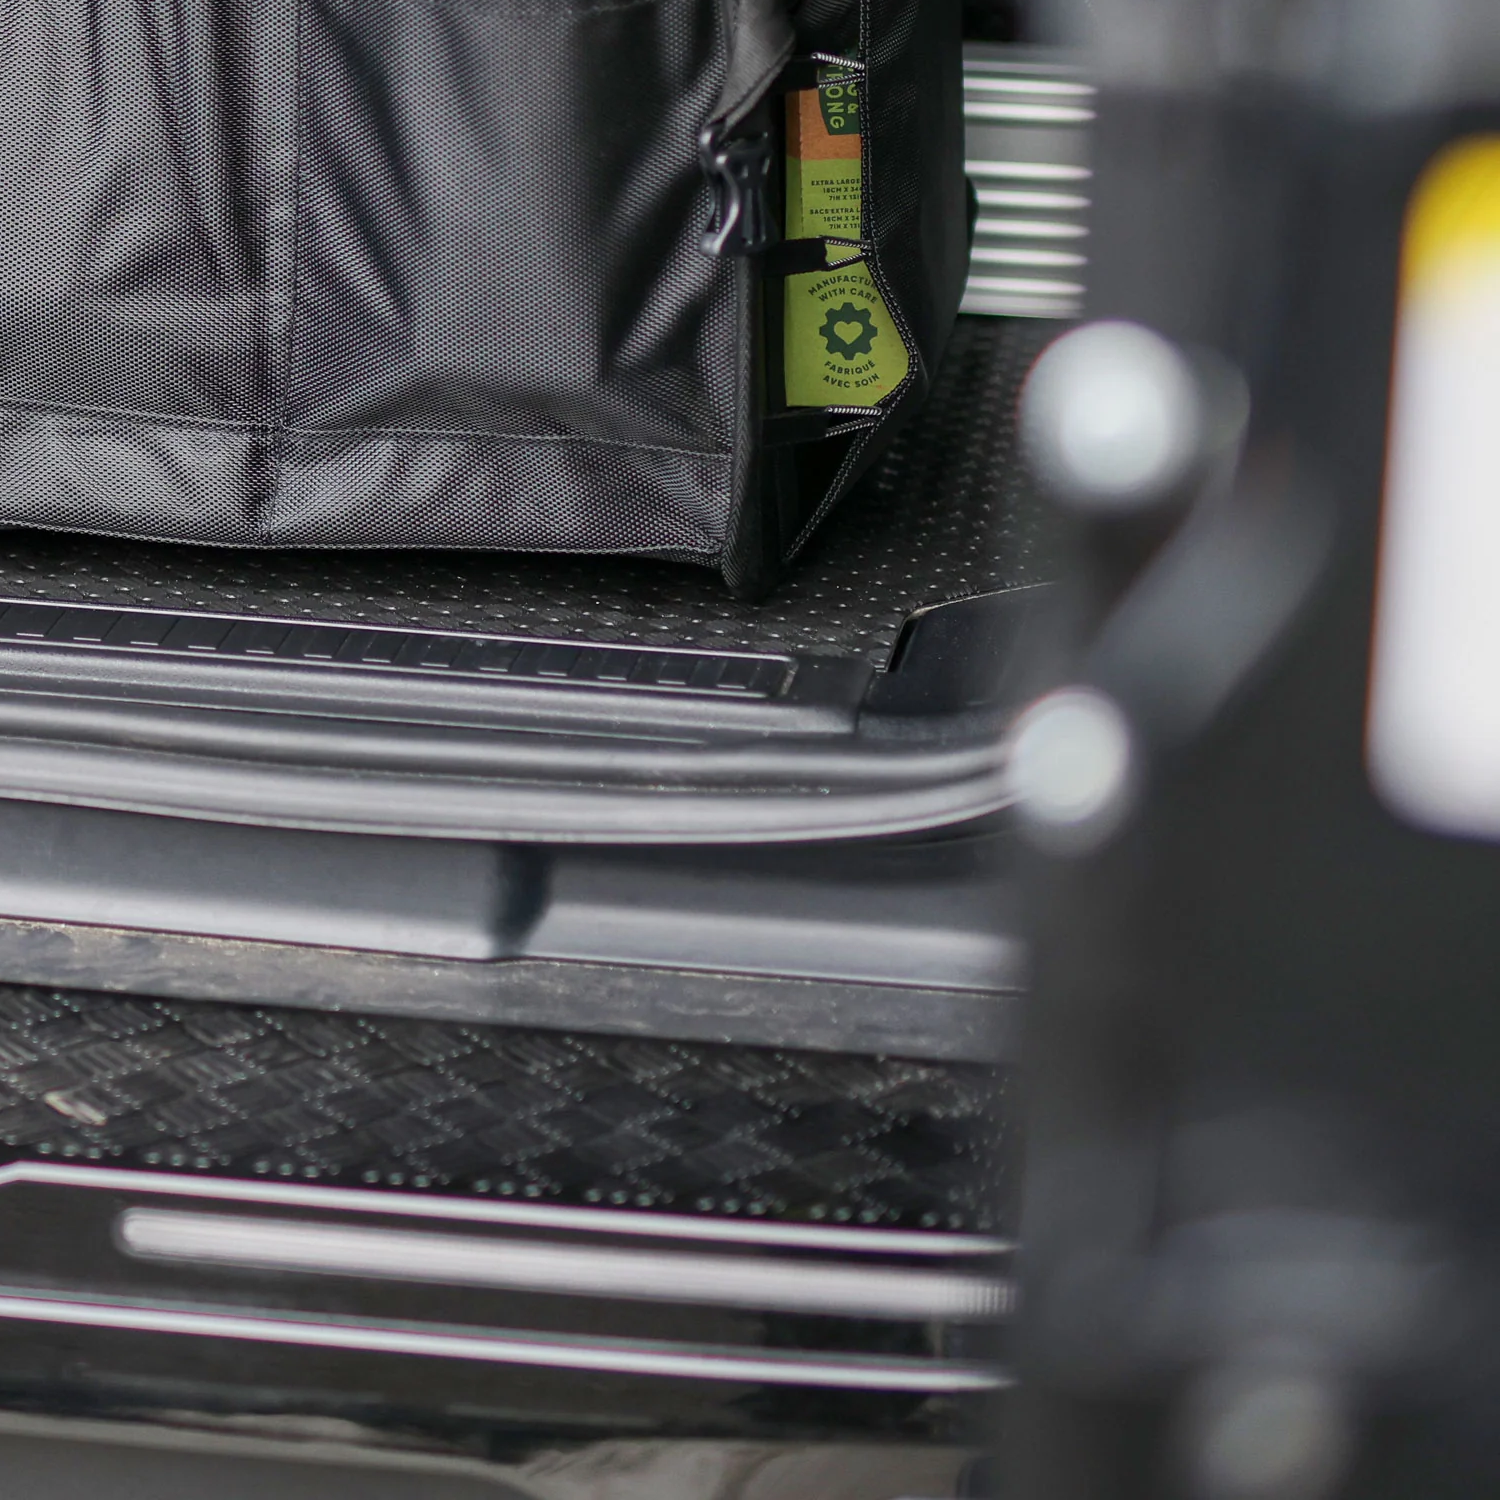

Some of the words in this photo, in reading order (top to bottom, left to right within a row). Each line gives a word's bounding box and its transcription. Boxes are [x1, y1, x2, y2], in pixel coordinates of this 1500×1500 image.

[819, 287, 846, 302] WITH
[850, 287, 878, 304] CARE
[824, 359, 876, 376] FABRIQUÉ
[823, 375, 851, 388] AVEC
[855, 373, 880, 388] SOIN
